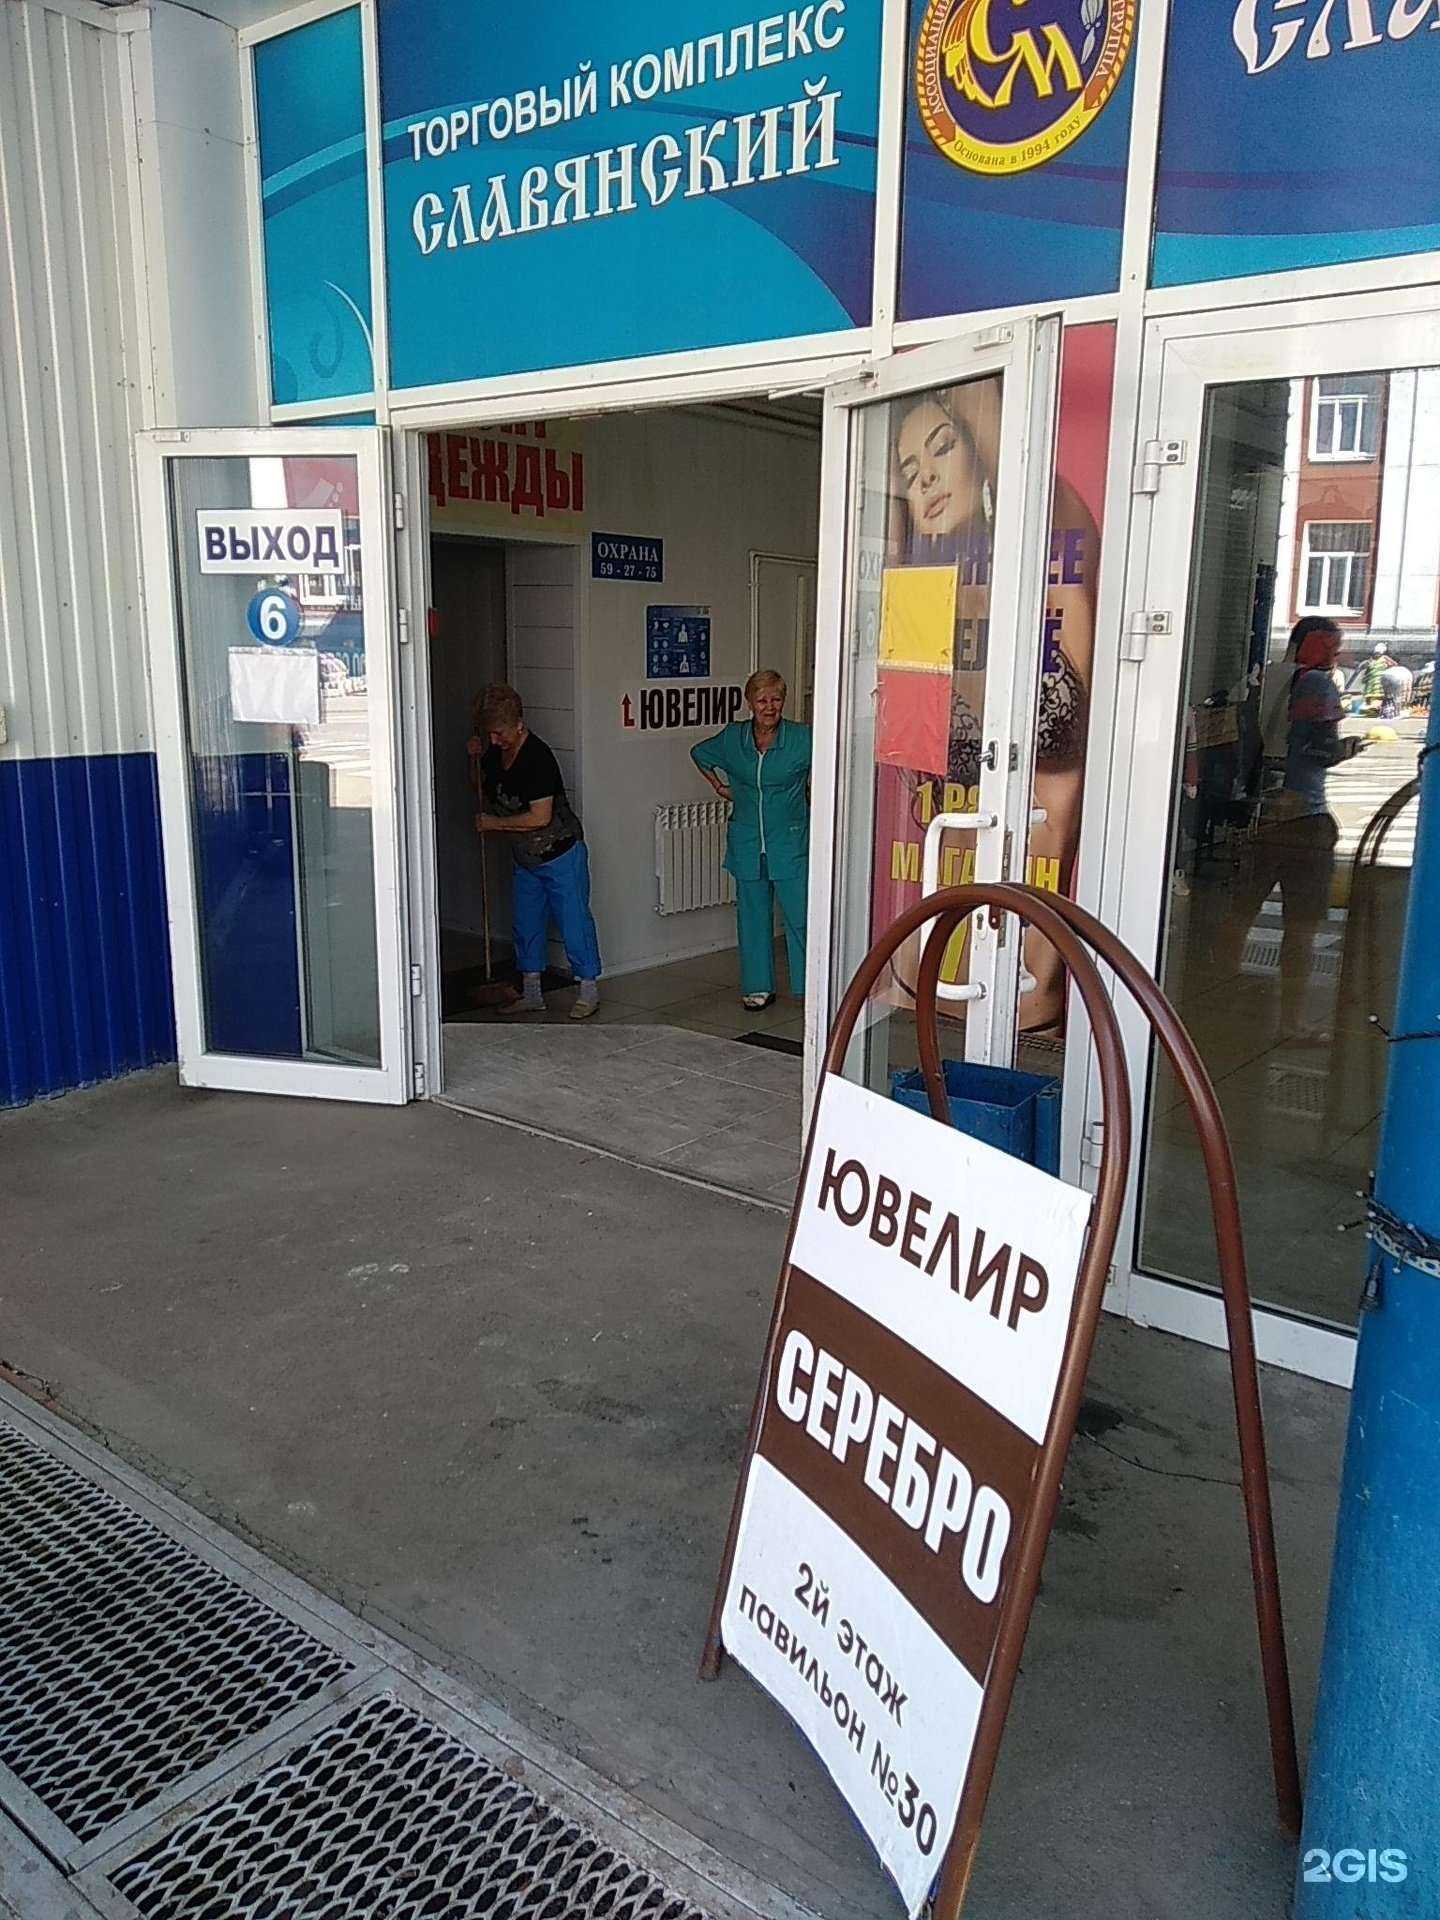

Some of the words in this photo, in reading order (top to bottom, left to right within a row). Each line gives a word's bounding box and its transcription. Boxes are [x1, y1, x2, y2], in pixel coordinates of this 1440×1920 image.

[408, 60, 597, 160] ТОРГОВЫЙ
[609, 0, 846, 107] КОМПЛЕКС
[413, 76, 841, 254] СЛАВЯНСКИЙ
[1021, 141, 1051, 162] 1994
[1054, 116, 1082, 144] году
[204, 525, 340, 568] ВЫХОД
[597, 542, 659, 562] ОХРАНА
[259, 595, 288, 641] 6
[640, 686, 742, 730] ЮВЕЛИР
[817, 1148, 1050, 1332] ЮВЕЛИР
[776, 1329, 1011, 1604] СЕРЕБРО
[739, 1584, 866, 1754] павильон
[870, 1739, 938, 1856] №30
[837, 1618, 909, 1728] этаж
